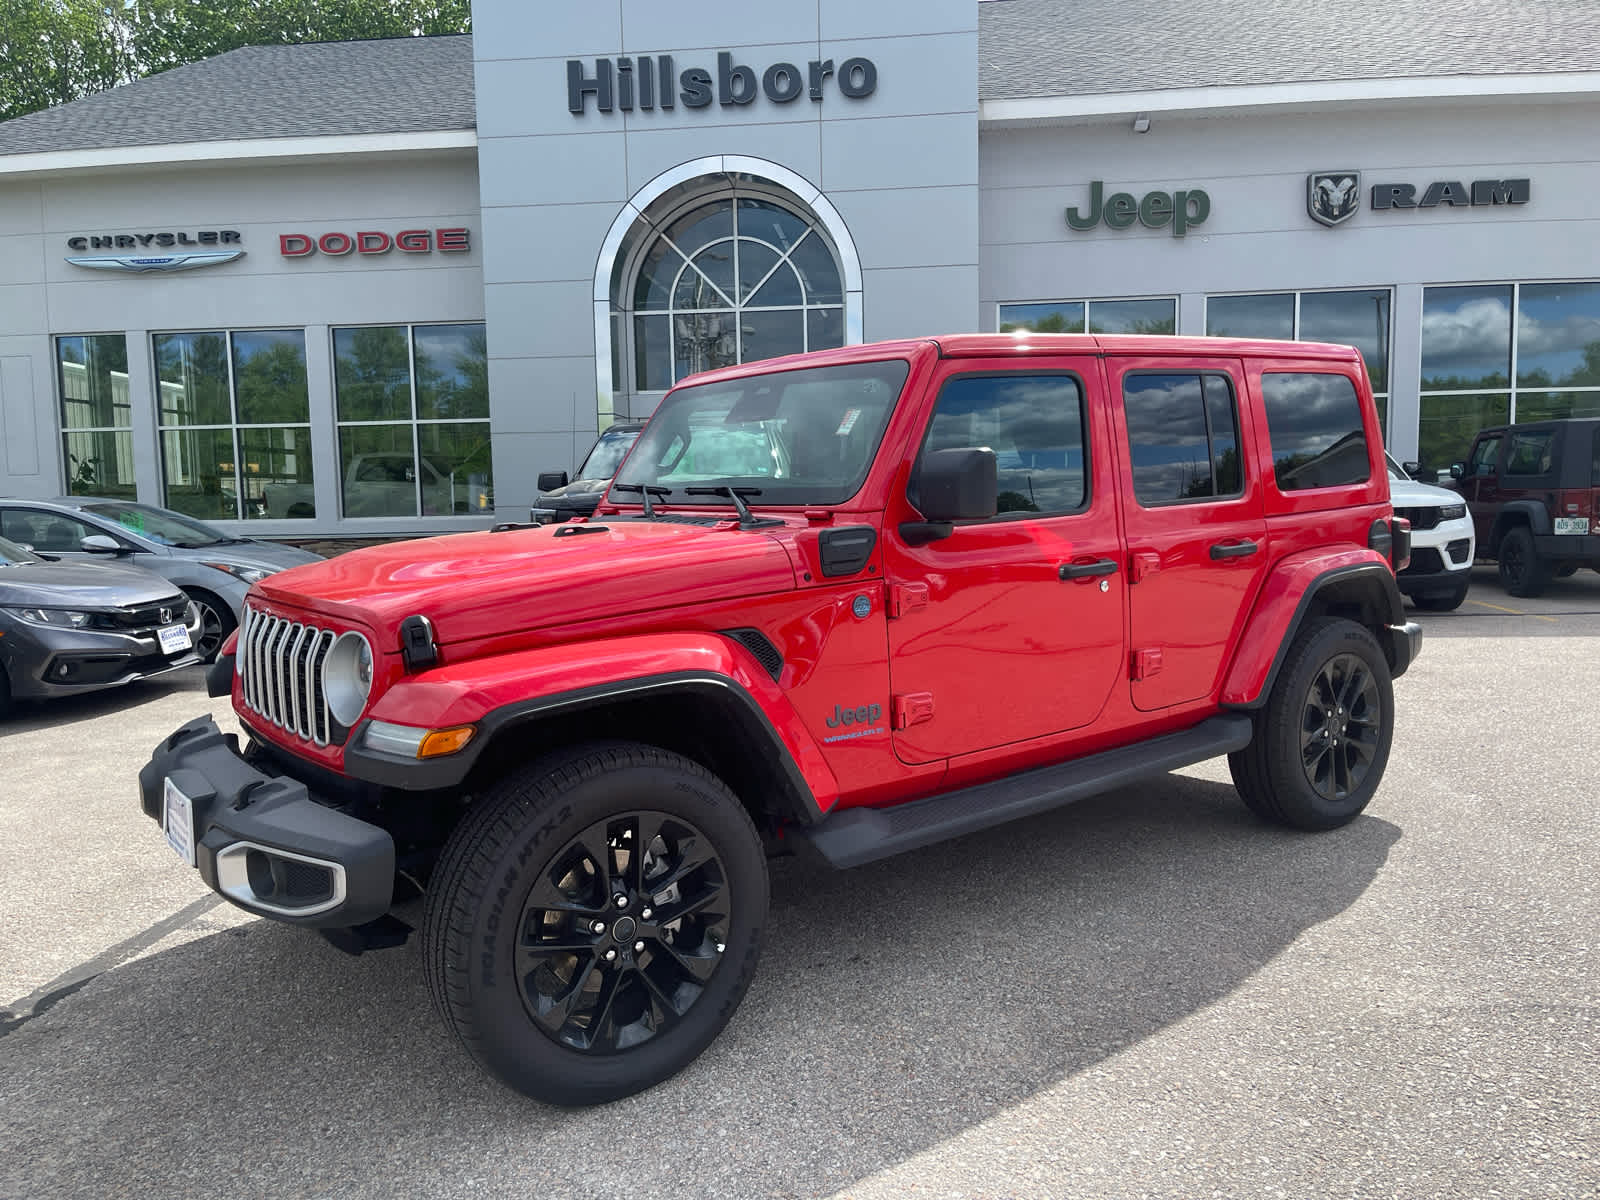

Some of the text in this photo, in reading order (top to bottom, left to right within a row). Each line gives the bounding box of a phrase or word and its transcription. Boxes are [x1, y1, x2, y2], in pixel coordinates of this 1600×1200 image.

[567, 51, 877, 114] Hillsboro
[1065, 181, 1210, 238] Jeep
[1371, 179, 1530, 210] RAM
[67, 230, 241, 250] CHRYSLER
[279, 228, 470, 257] DODGE
[825, 704, 882, 728] Jeep
